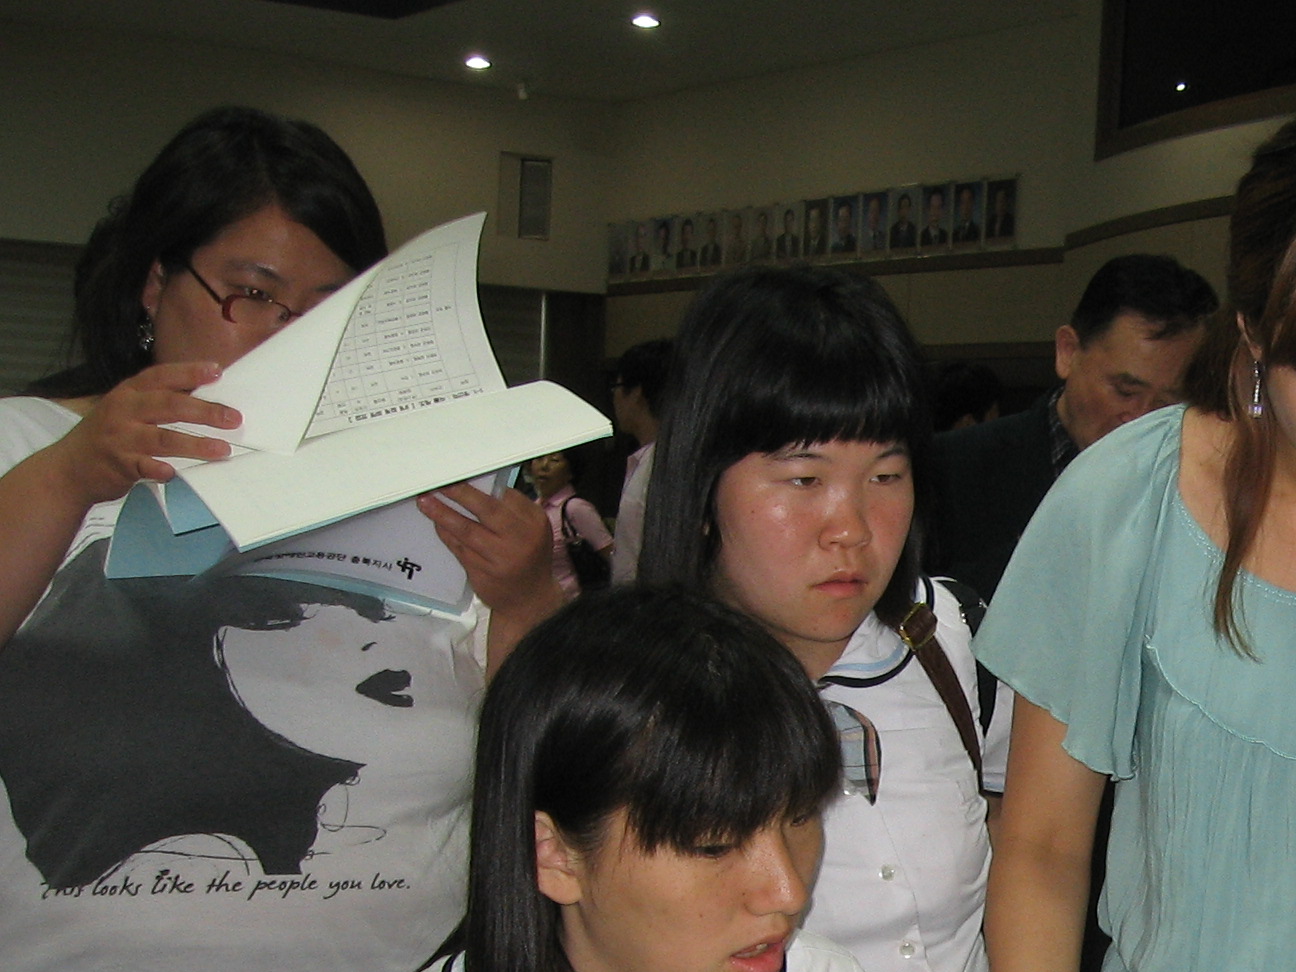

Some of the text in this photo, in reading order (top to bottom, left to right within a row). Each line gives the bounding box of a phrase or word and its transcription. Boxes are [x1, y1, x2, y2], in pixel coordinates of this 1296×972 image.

[92, 876, 142, 897] looks
[150, 870, 195, 895] like
[204, 871, 244, 894] the
[247, 873, 319, 900] people
[323, 878, 364, 900] you
[369, 874, 411, 891] love.
